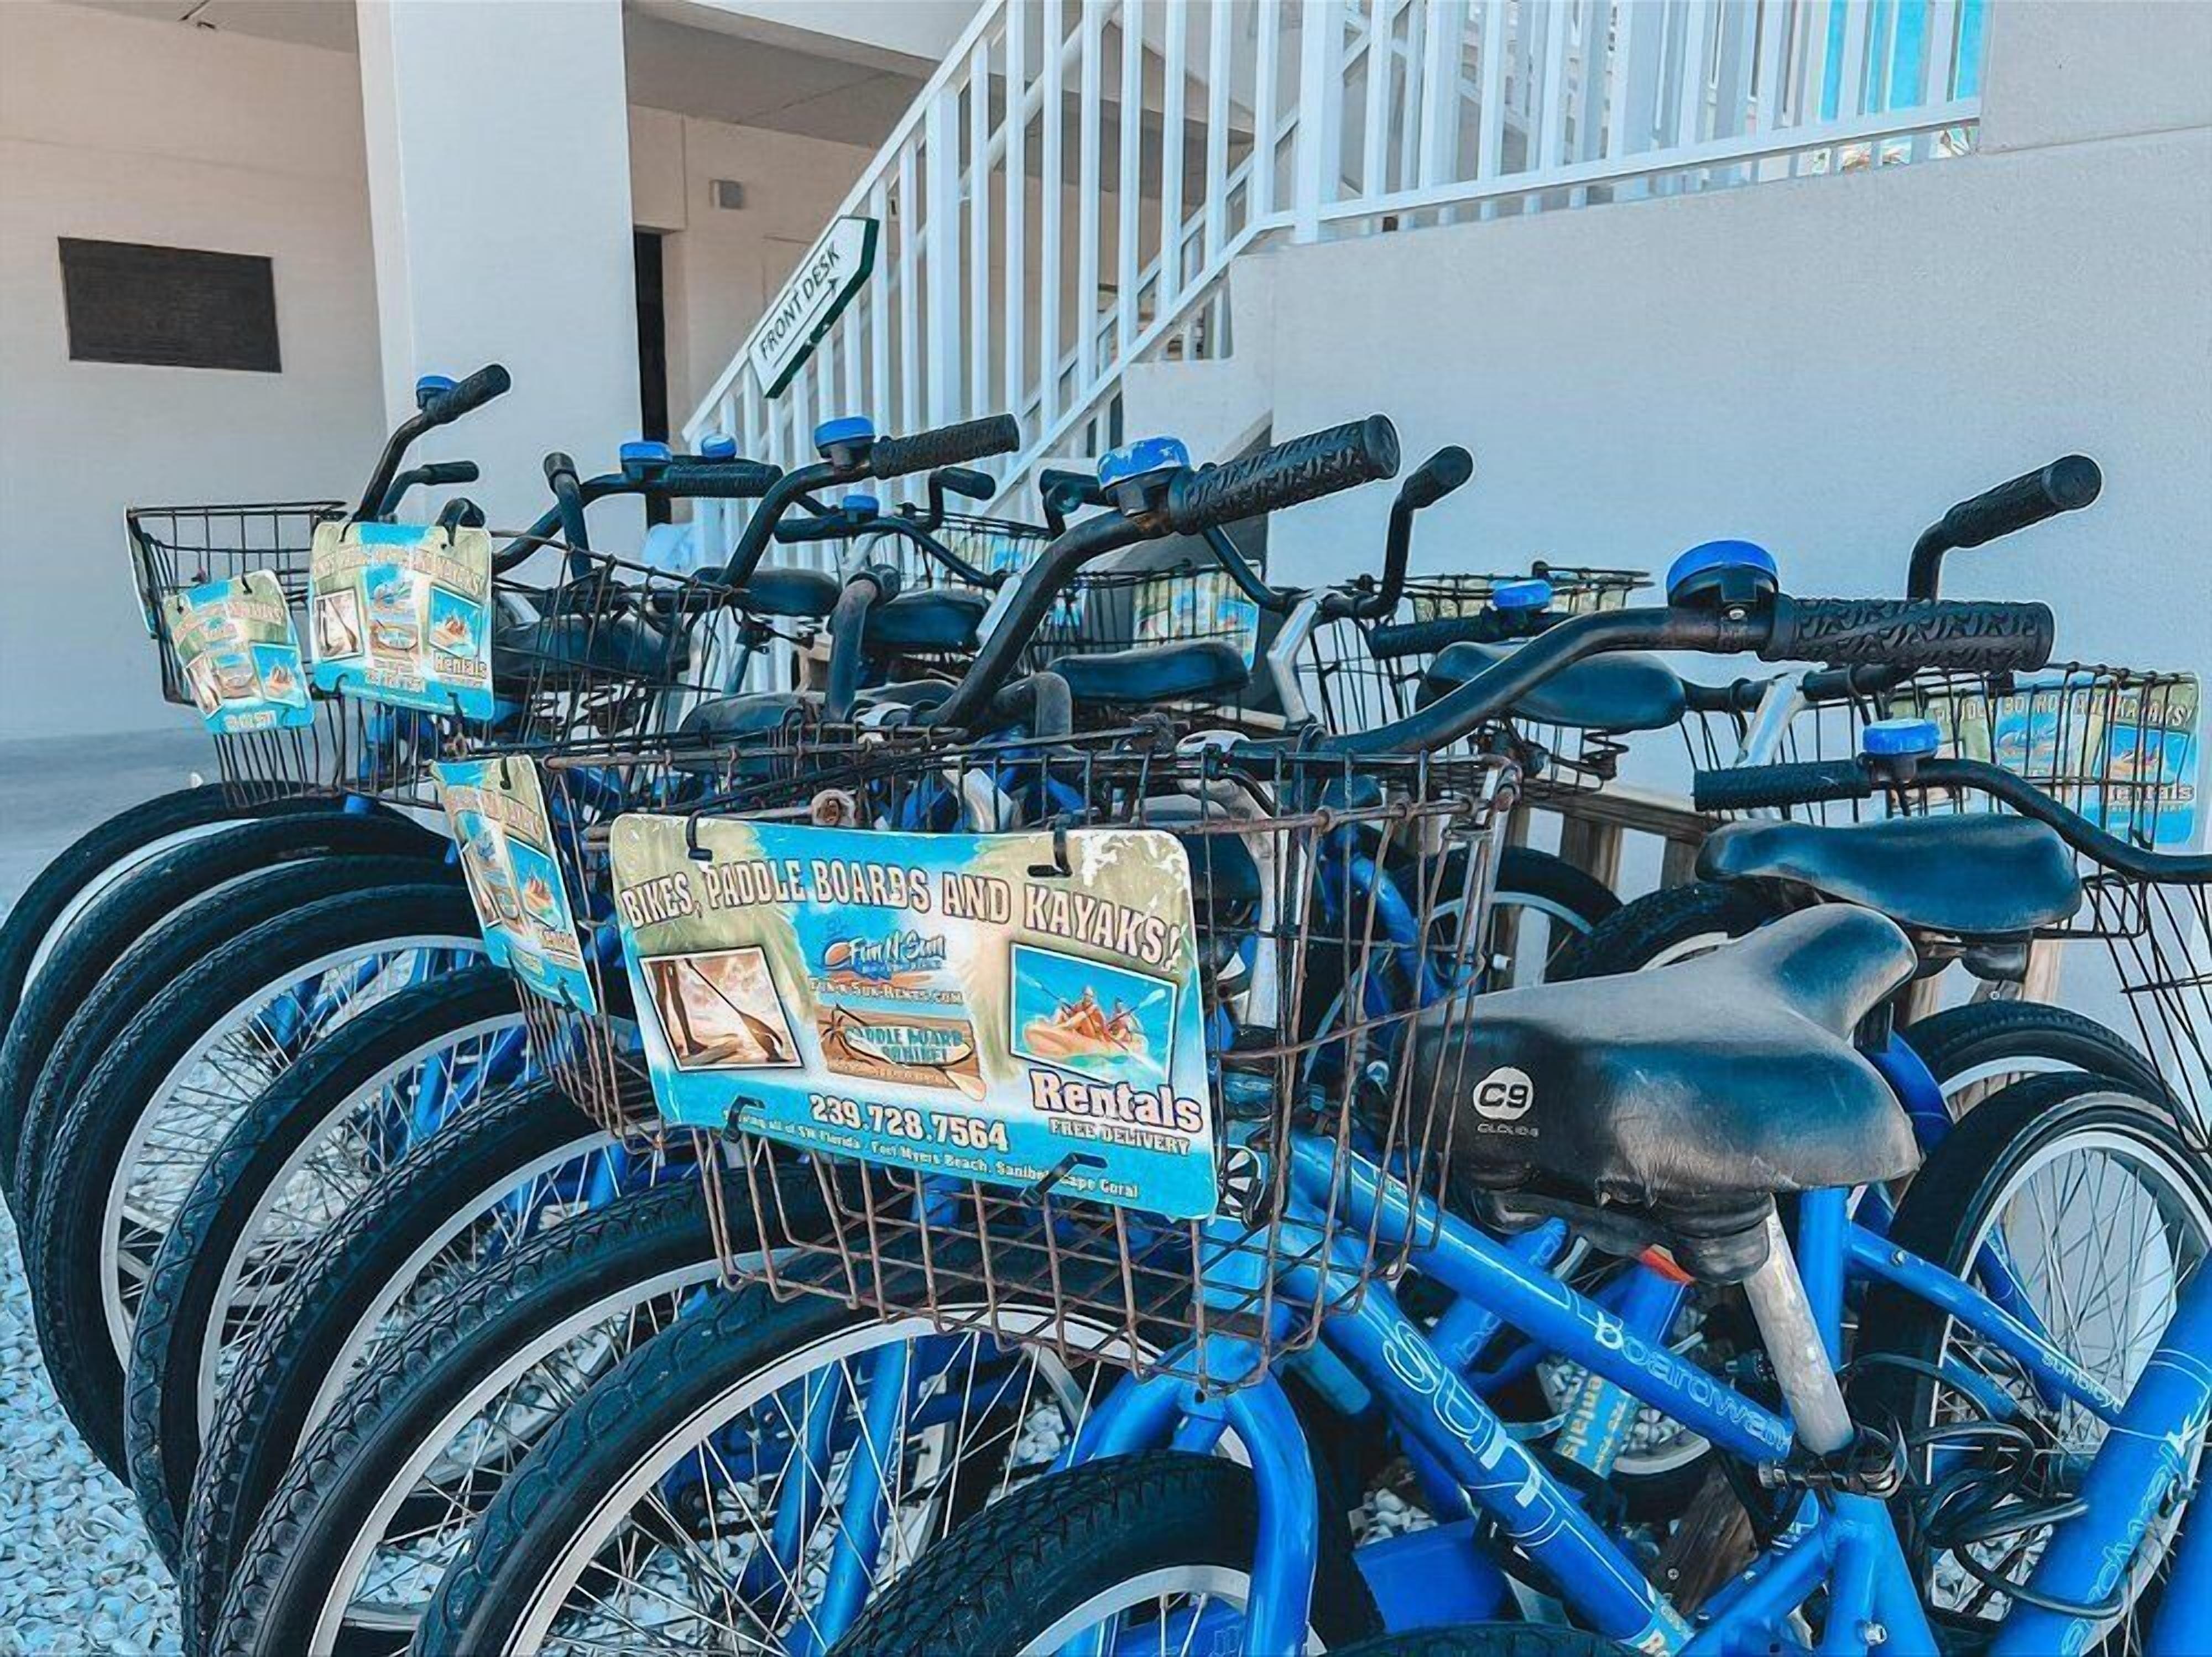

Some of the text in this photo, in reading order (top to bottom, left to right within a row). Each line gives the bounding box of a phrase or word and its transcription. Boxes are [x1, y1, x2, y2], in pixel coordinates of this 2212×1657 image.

[759, 242, 840, 360] FRONT DESK
[620, 858, 1182, 972] BIKES, PADDLE BOARDS AND KAYAKS!
[808, 1092, 1010, 1153] 239.728.7564
[1029, 1069, 1203, 1133] Rentals
[1479, 1082, 1530, 1108] C9
[1049, 1117, 1097, 1141] FREE
[1099, 1178, 1138, 1199] Coral
